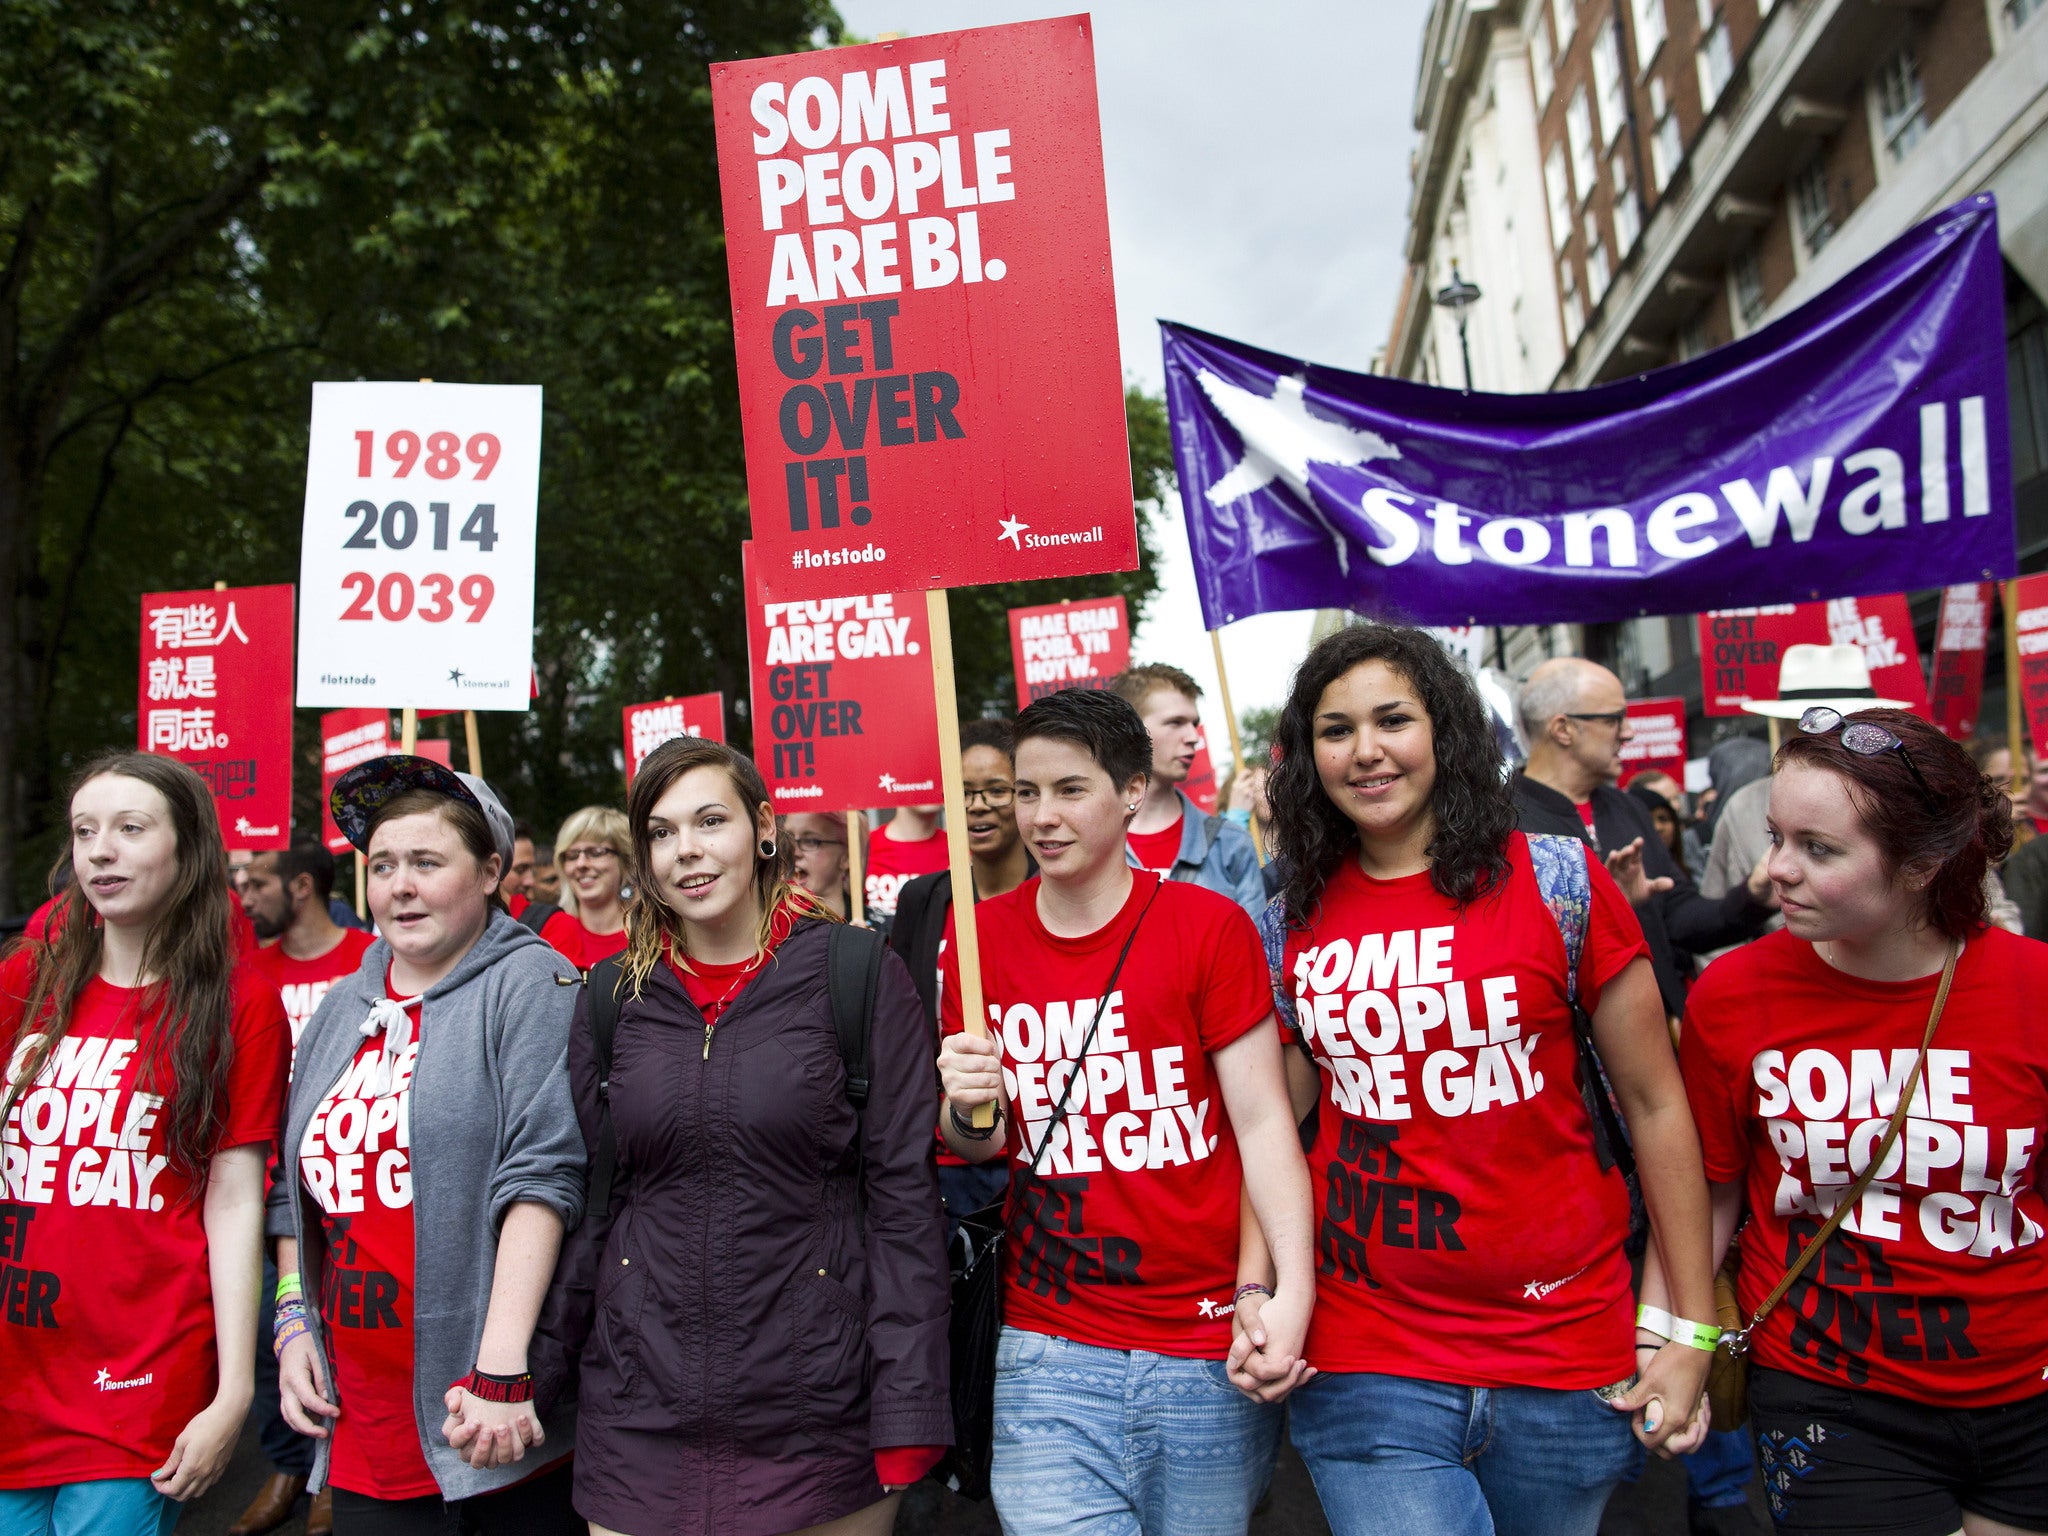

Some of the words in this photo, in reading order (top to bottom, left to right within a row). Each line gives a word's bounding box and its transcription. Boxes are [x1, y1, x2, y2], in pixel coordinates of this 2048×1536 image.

[750, 59, 951, 155] SOME
[757, 128, 1016, 230] PEOPLE
[766, 222, 902, 307] ARE
[908, 211, 1007, 290] BI.
[772, 299, 900, 381] GET
[779, 371, 966, 456] OVER
[354, 430, 502, 481] 1989
[785, 455, 873, 532] IT!
[1361, 396, 1991, 567] Stonewall
[342, 501, 499, 552] 2014
[1025, 527, 1103, 549] Stonewall
[792, 545, 887, 569] #lotstodo
[338, 571, 495, 623] 2039
[149, 601, 249, 650] 有些人
[766, 622, 836, 665] ARE
[837, 616, 921, 660] GAY.
[1020, 613, 1067, 641] MAE
[1712, 618, 1757, 640] GET
[147, 655, 217, 700] 就是
[1714, 641, 1778, 666] OVER
[321, 674, 376, 686] #lotstodo
[463, 679, 510, 689] Stonewall
[769, 663, 832, 701] GET
[1716, 669, 1745, 691] IT!
[147, 707, 229, 752] 同志。
[631, 704, 685, 735] SOME
[771, 699, 864, 740] OVER
[773, 741, 816, 779] IT!
[775, 785, 824, 799] #lotstodo
[892, 780, 934, 793] Stonewall
[1296, 975, 1521, 1058] PEOPLE
[6, 1033, 138, 1089] OME
[1421, 1032, 1545, 1118] GAY.
[1752, 1048, 1974, 1123] SOME
[1, 1085, 164, 1151] EOPLE
[0, 1145, 61, 1204] RE
[67, 1146, 168, 1213] GAY.
[1767, 1117, 2035, 1197] PEOPLE
[301, 1153, 365, 1214] RE
[1326, 1160, 1466, 1252] OVER
[1787, 1277, 1981, 1361] OVER
[104, 1373, 153, 1391] Stonewall
